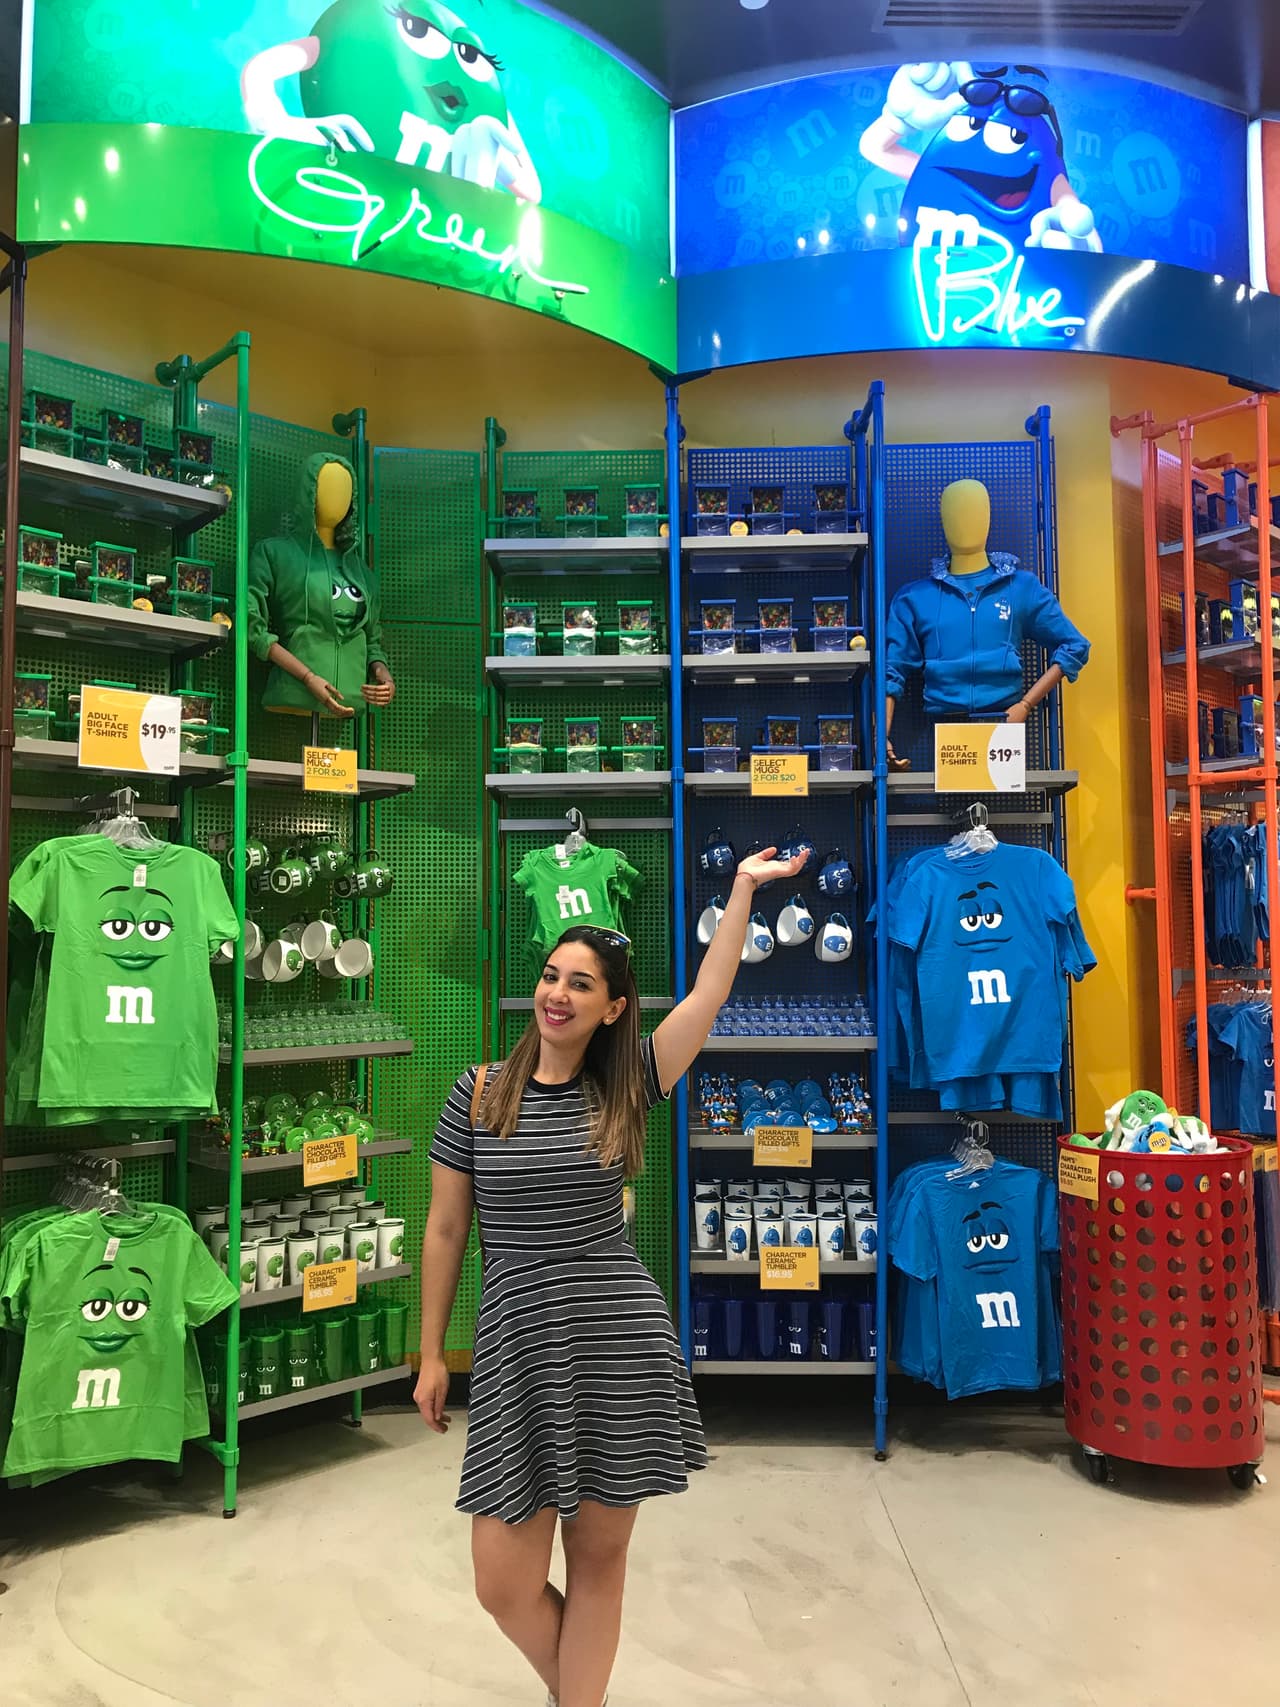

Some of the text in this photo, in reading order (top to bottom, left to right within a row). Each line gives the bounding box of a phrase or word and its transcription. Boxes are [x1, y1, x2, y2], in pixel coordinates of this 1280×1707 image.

[916, 205, 980, 248] m
[912, 224, 1086, 342] Blue
[87, 711, 119, 721] ADULT
[86, 719, 129, 731] BIG FACE
[86, 728, 128, 739] T-SHIRTS
[306, 751, 338, 761] SELECT
[306, 767, 312, 775] 2
[313, 768, 330, 776] FOR
[332, 768, 347, 777] $20
[754, 766, 780, 774] MUGS
[968, 968, 1011, 1005] m
[105, 985, 155, 1024] m
[306, 1141, 345, 1153] CHARACTER
[306, 1148, 345, 1158] CHOCOLATE
[306, 1152, 346, 1164] FILLED GIFTS
[1060, 1162, 1092, 1174] CHARACTER
[1060, 1169, 1096, 1183] SMALL PLUSH
[309, 1266, 347, 1278] CHARACTER
[308, 1274, 337, 1284] CERAMIC
[308, 1280, 338, 1290] TUMBLER
[976, 1291, 1020, 1329] m
[71, 1367, 122, 1409] m
